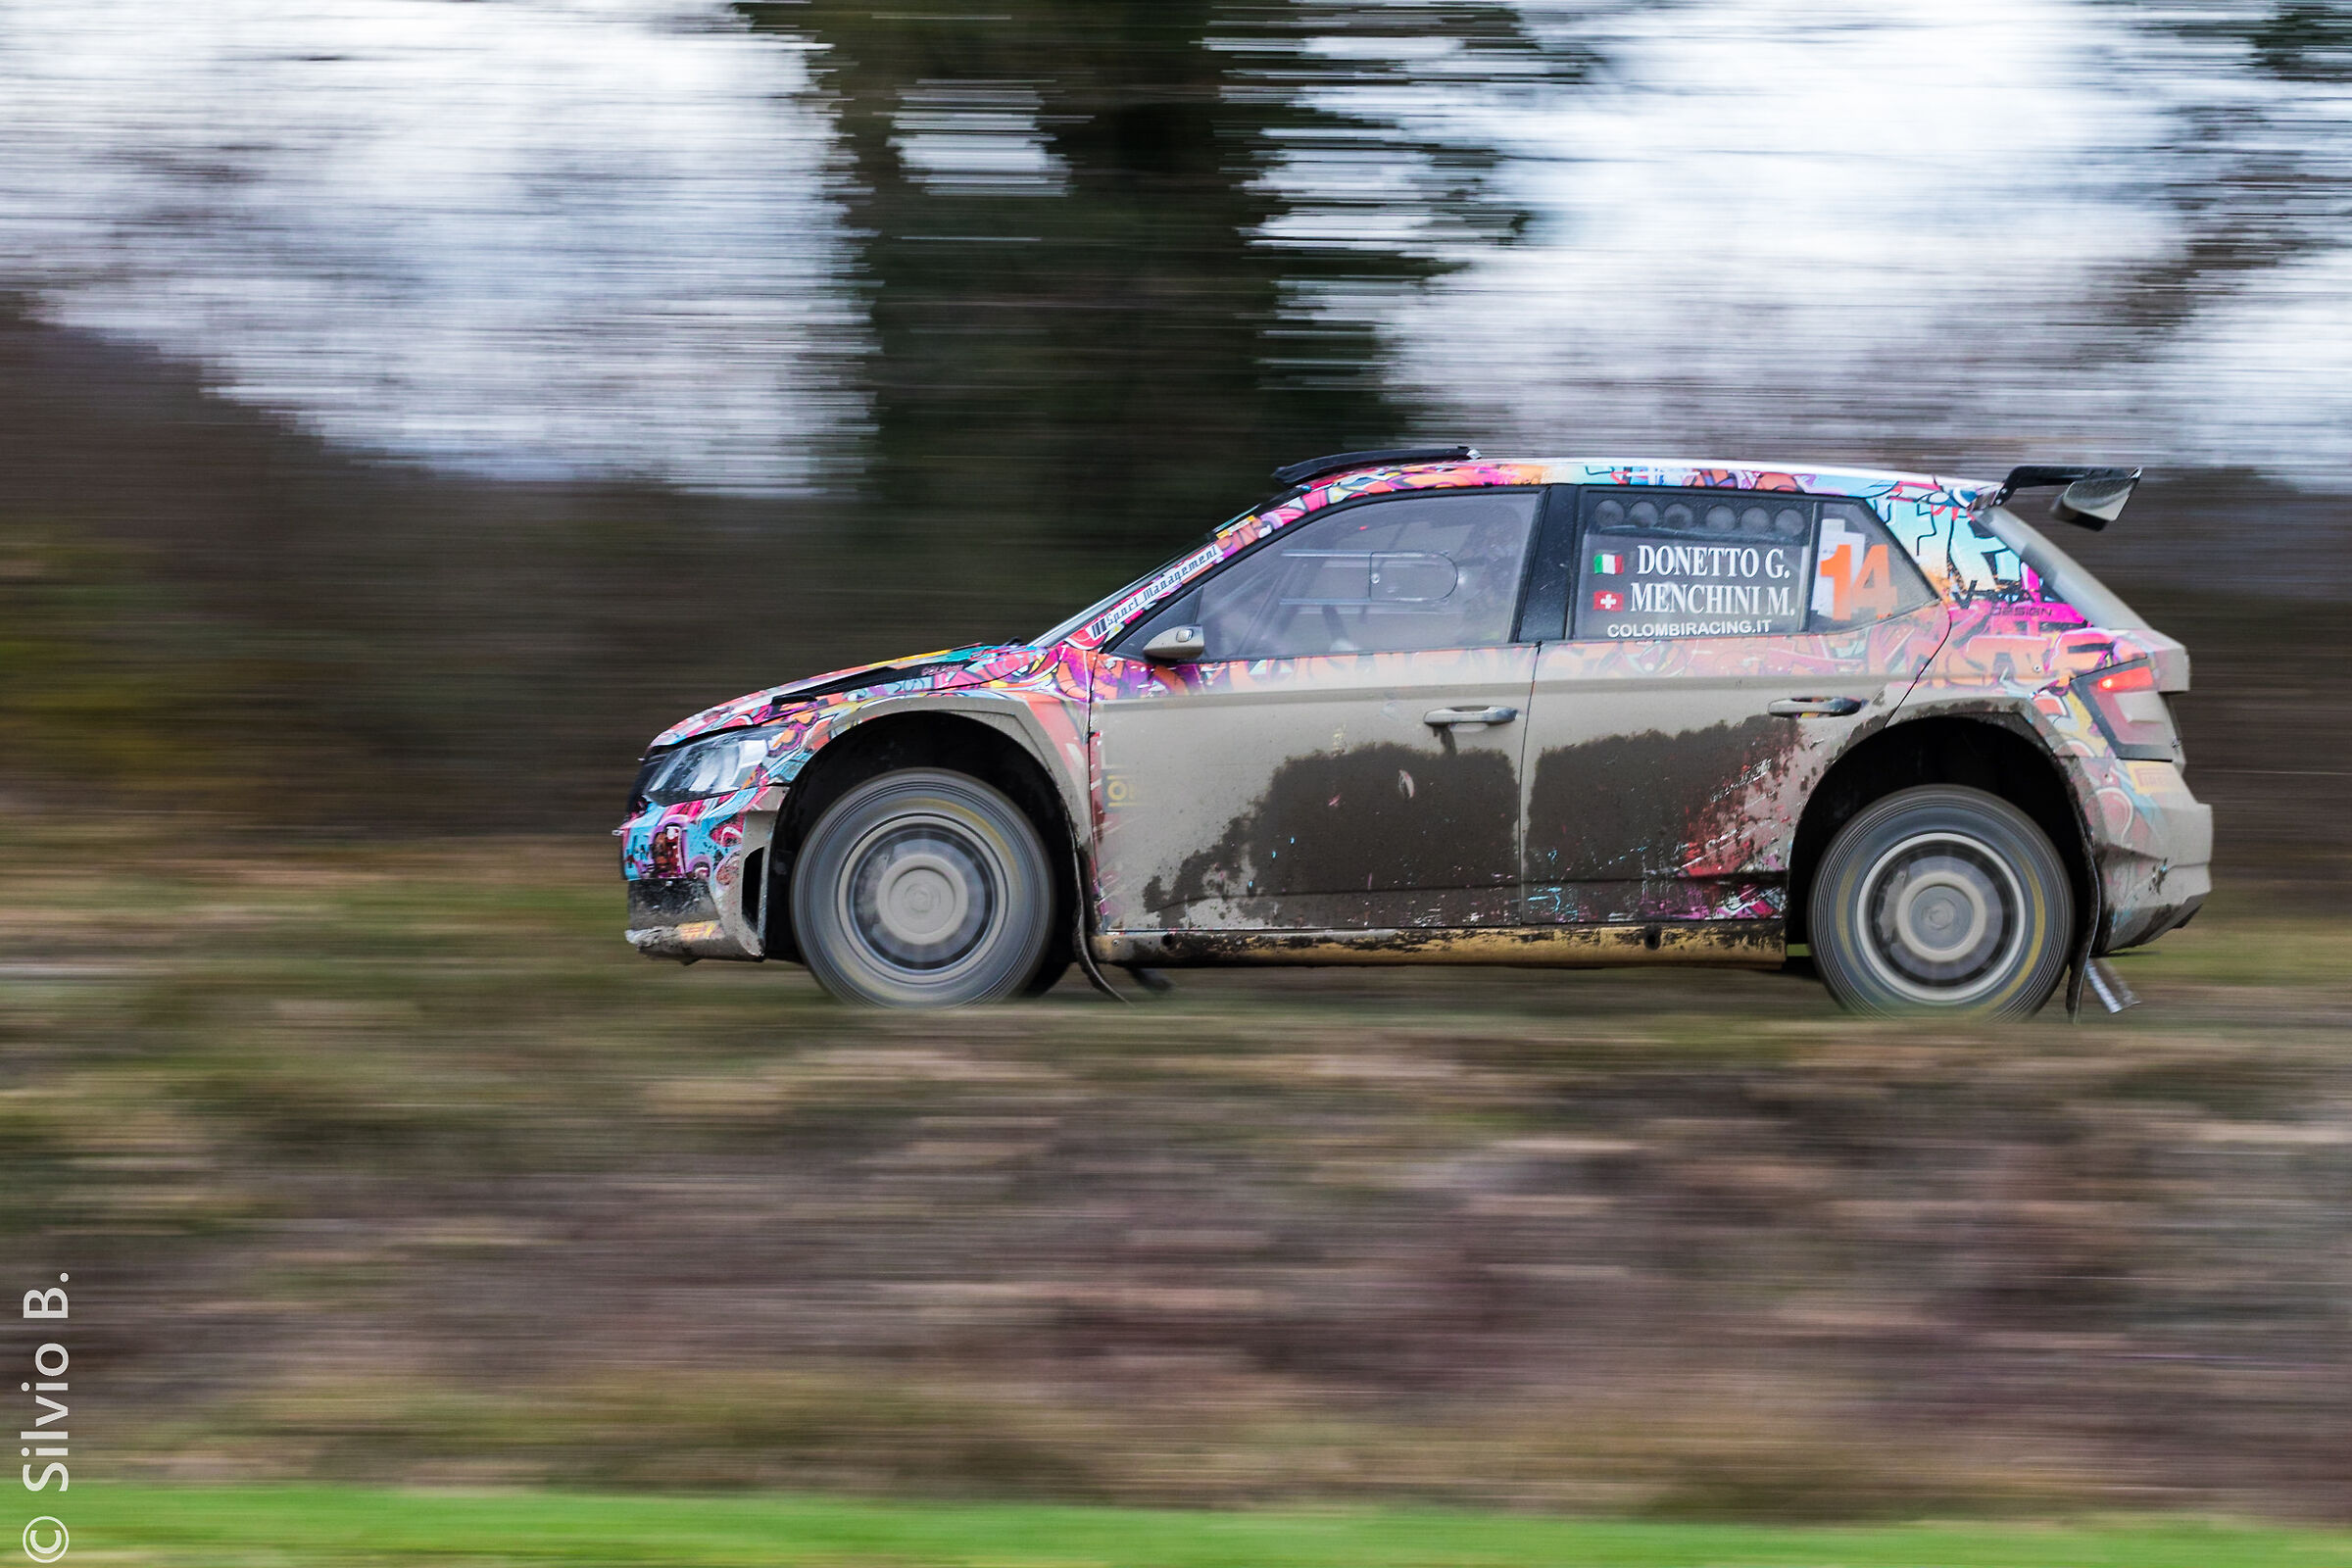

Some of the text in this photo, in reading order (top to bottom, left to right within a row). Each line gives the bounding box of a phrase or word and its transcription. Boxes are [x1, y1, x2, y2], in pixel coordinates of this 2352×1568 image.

[1143, 545, 1218, 601] Management
[1637, 545, 1791, 579] DONETTO G.
[1630, 581, 1796, 617] MENCHINI M.
[1820, 543, 1898, 620] 14
[1606, 618, 1773, 638] COLOMBIRACING.IT
